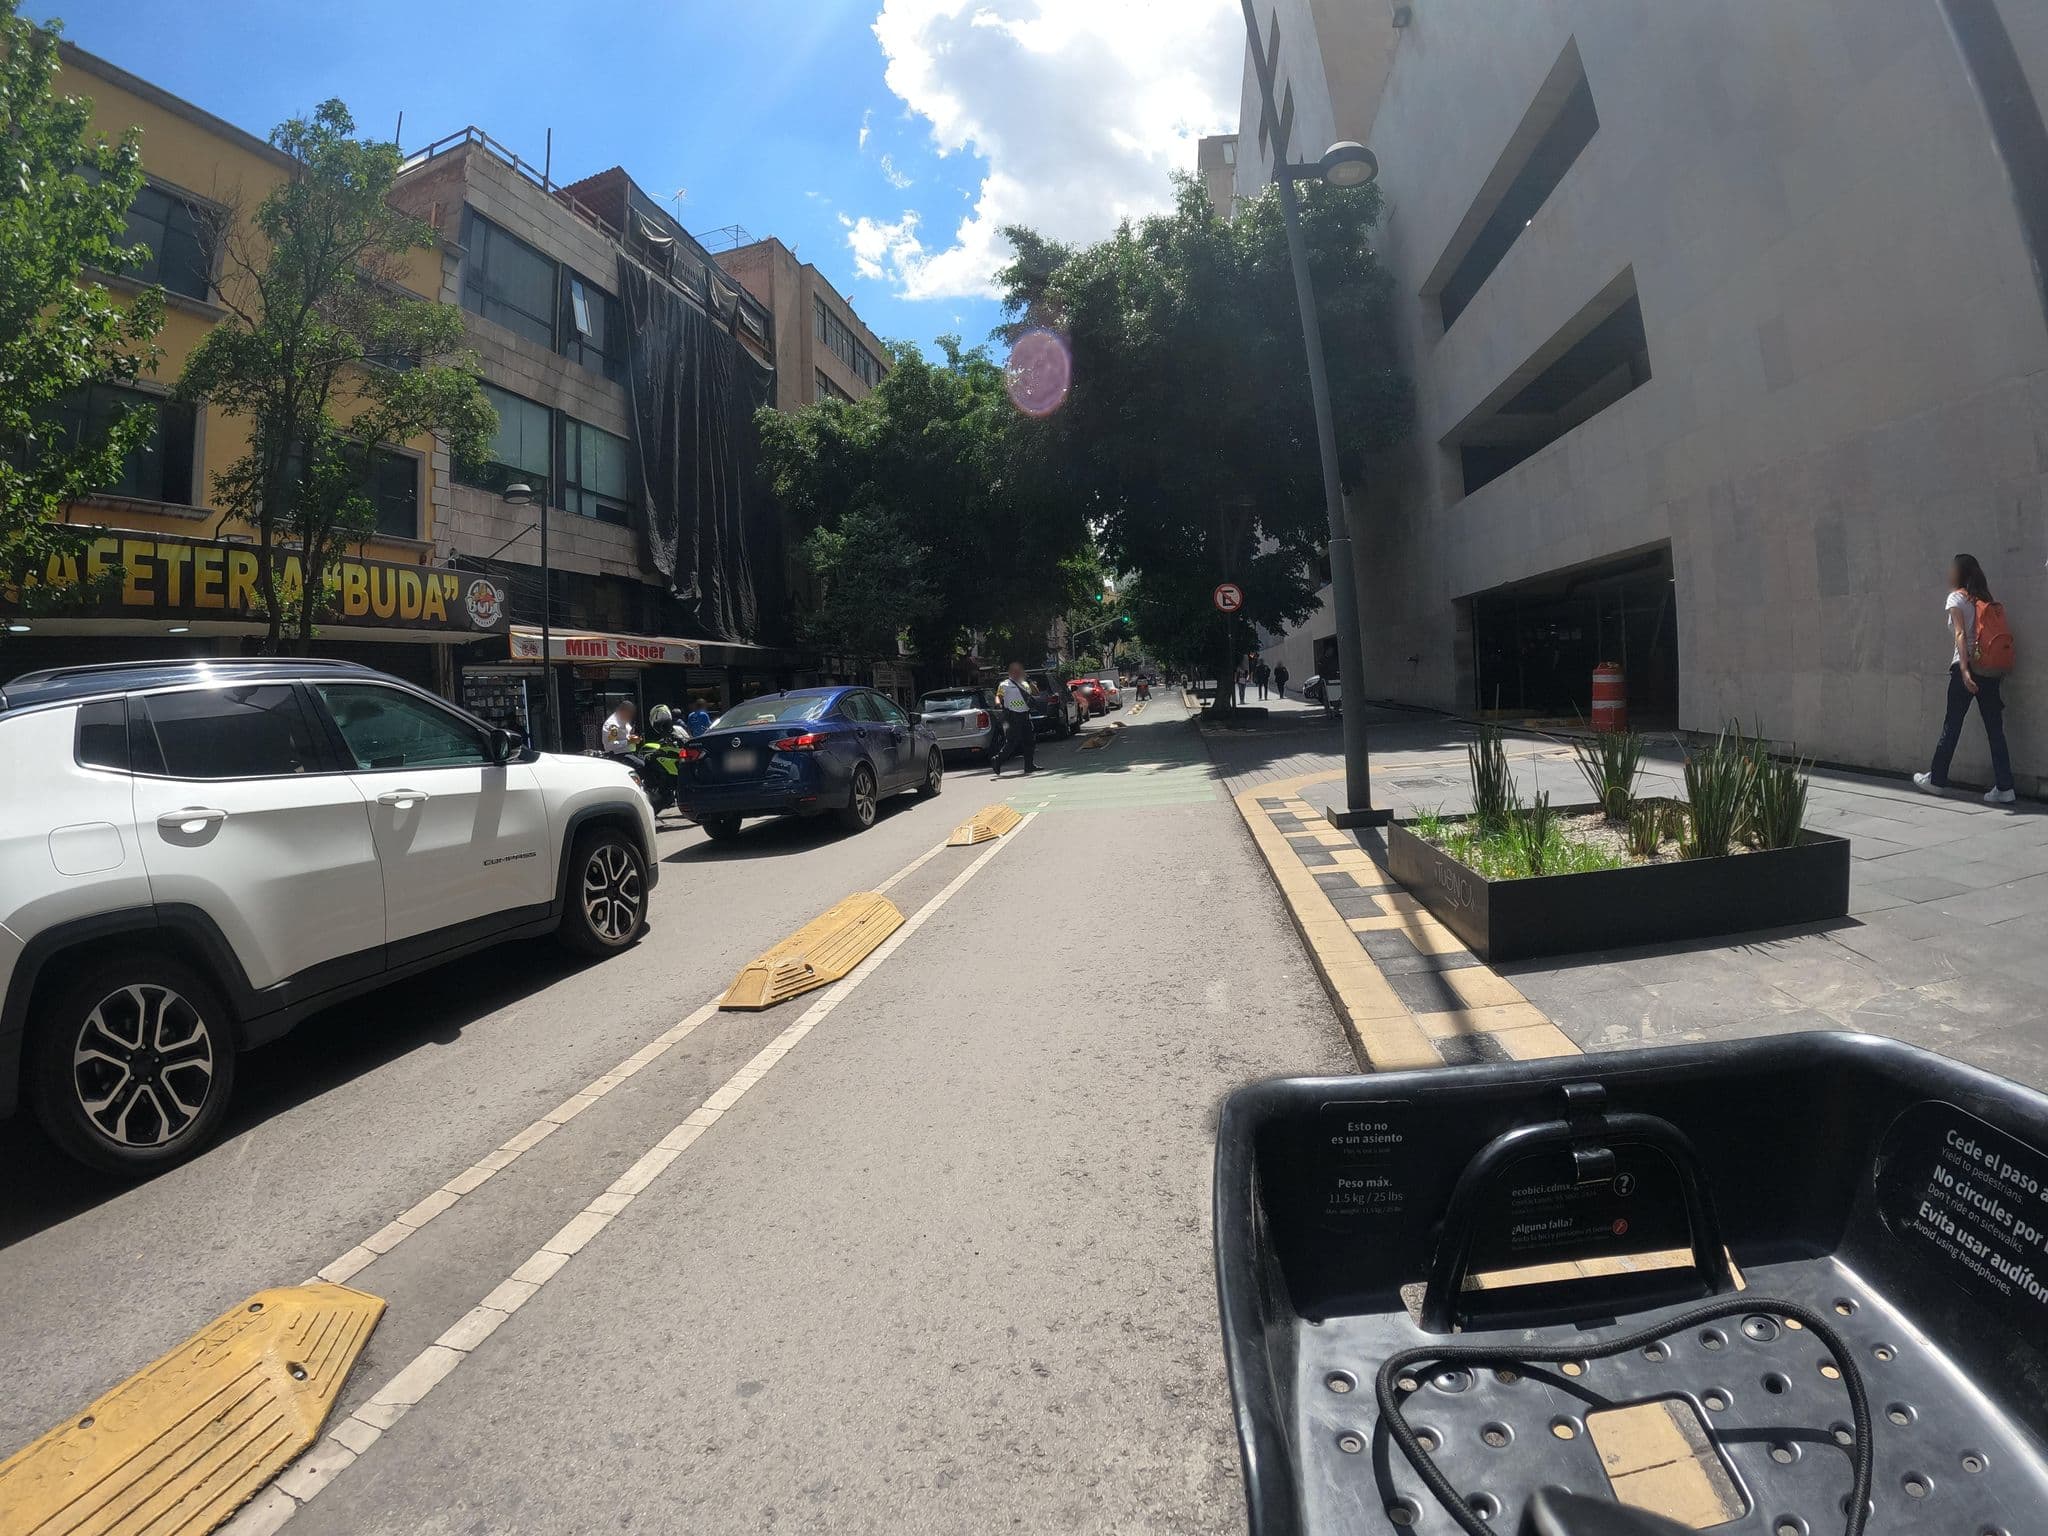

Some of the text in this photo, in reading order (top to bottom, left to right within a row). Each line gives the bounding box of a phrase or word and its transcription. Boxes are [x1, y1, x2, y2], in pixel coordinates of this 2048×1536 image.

[2, 531, 303, 611] AFETERA
[565, 639, 666, 660] Mini Super
[1331, 1133, 1403, 1145] es un asiento
[1347, 1122, 1388, 1132] Esto no
[1338, 1175, 1393, 1189] Peso máx.
[1942, 1147, 2024, 1205] Yield to pedestrians.
[1946, 1129, 1982, 1160] Cede
[1984, 1154, 2000, 1171] el
[2000, 1163, 2038, 1194] paso
[1330, 1193, 1350, 1204] 11.5
[1352, 1192, 1365, 1205] kg
[1373, 1191, 1386, 1202] 25
[1388, 1190, 1404, 1201] lbs
[1933, 1164, 2044, 1246] No circules por
[1511, 1217, 1573, 1235] ¿Alguna falla?
[1919, 1200, 1955, 1236] Evita
[1956, 1229, 1991, 1258] usar
[1951, 1199, 1967, 1215] ride
[1968, 1211, 1980, 1223] on
[1980, 1219, 2024, 1255] sidewalks.
[1913, 1219, 2012, 1297] Avoid using headphones.
